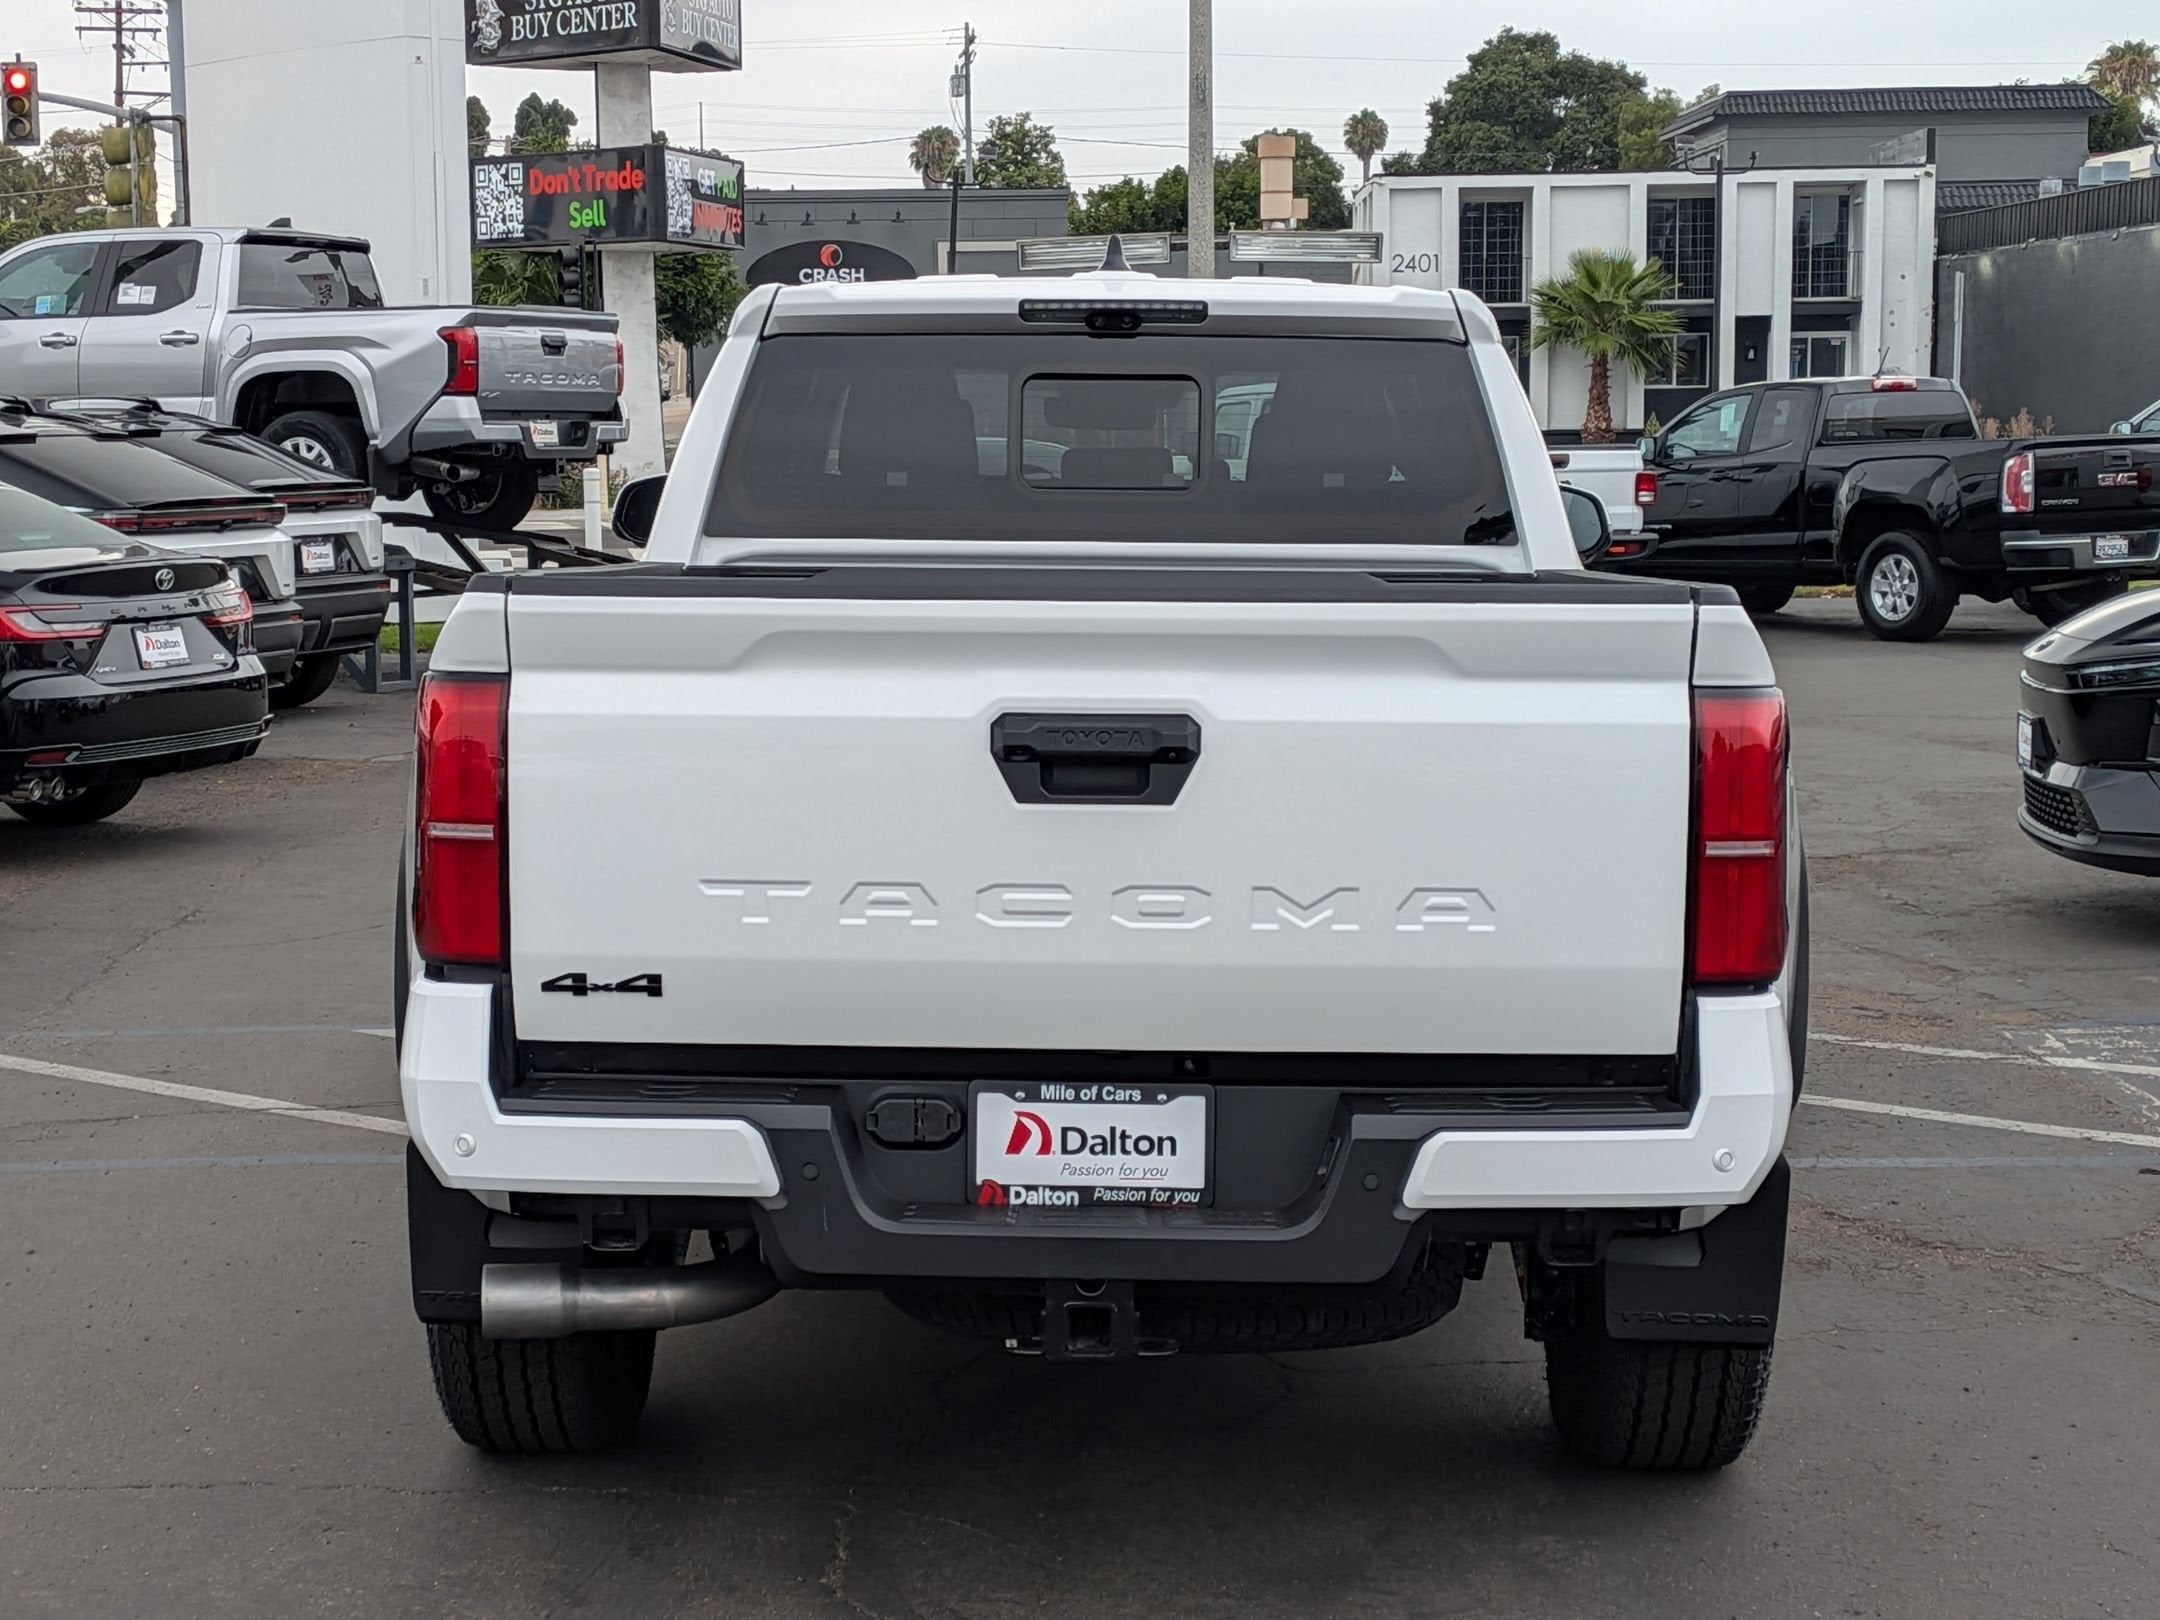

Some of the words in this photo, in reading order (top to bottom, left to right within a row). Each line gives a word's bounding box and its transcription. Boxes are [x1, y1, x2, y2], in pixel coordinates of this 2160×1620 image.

[510, 12, 552, 41] BUY
[556, 2, 639, 36] CENTER
[682, 9, 702, 38] BUY
[529, 166, 581, 195] Don't
[583, 161, 645, 191] Trade
[698, 167, 715, 195] GET
[568, 199, 606, 229] Sell
[1392, 253, 1439, 273] 2401
[798, 267, 865, 283] CRASH
[504, 371, 601, 386] TACOMA
[155, 638, 181, 650] Dalton
[1046, 729, 1145, 746] TOYOTA
[698, 878, 1497, 933] TACOMA
[1041, 1085, 1076, 1101] Mile
[1080, 1086, 1100, 1101] of
[1102, 1086, 1142, 1102] Cars
[1060, 1126, 1178, 1157] Dalton
[1060, 1163, 1114, 1177] Passion
[1118, 1163, 1140, 1178] for
[1141, 1166, 1169, 1179] you
[1008, 1186, 1080, 1206] Dalton
[1093, 1187, 1147, 1202] Passion
[1150, 1188, 1171, 1203] for
[1171, 1191, 1201, 1206] you
